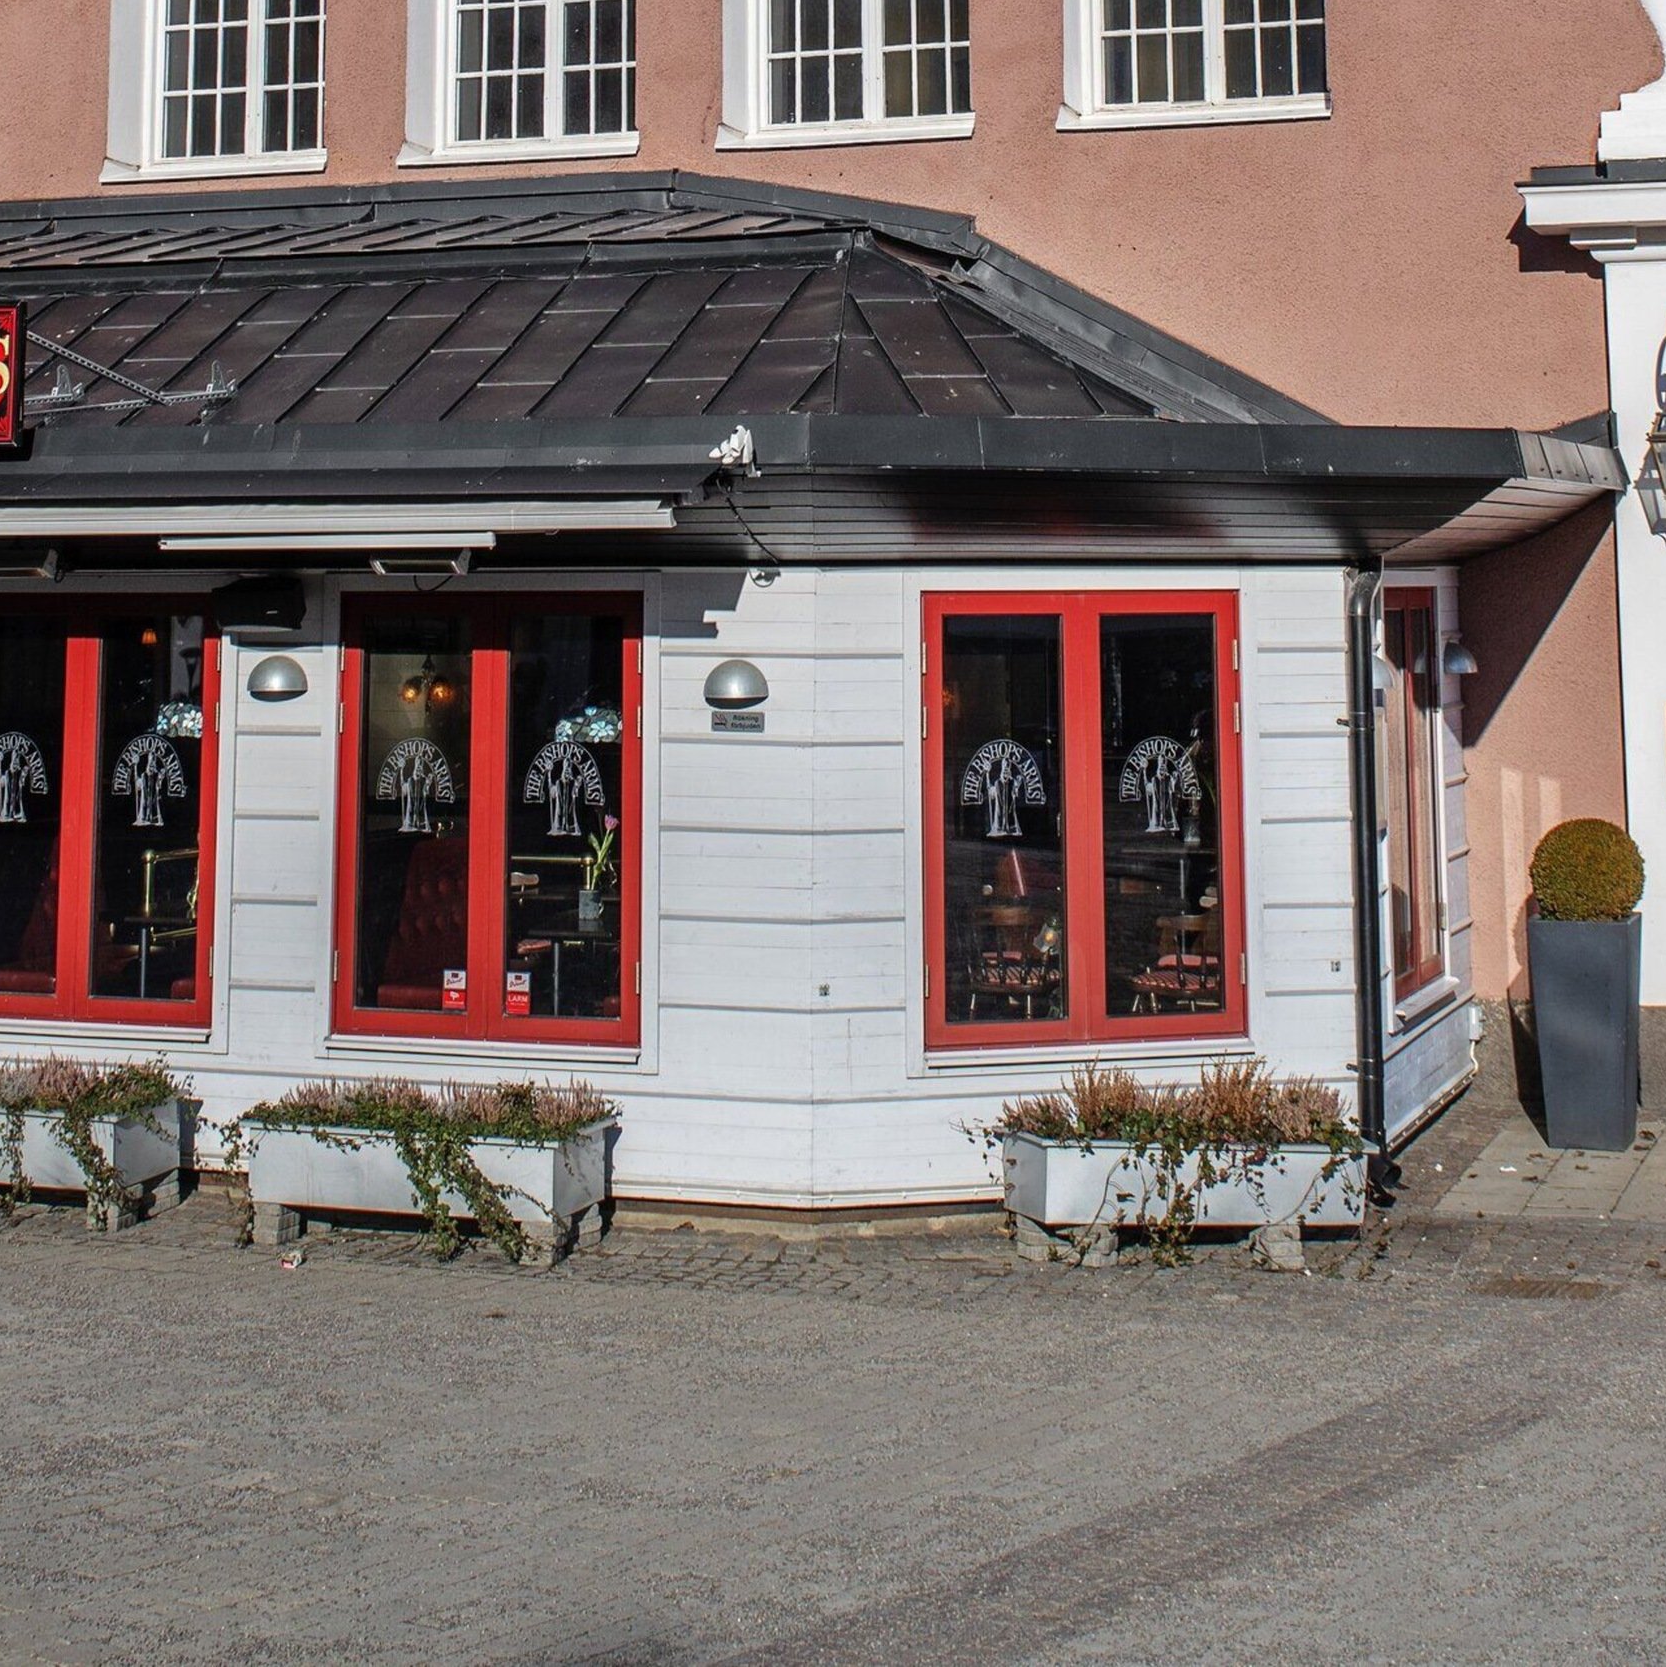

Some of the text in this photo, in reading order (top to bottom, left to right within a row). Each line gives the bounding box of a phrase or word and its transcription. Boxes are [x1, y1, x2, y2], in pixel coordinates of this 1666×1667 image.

[26, 750, 45, 790] ARMS
[114, 737, 183, 793] THE BISHOPS ARMS
[379, 740, 450, 799] THE BISHOPS ARMS
[526, 742, 601, 802] THE BISHOPS ARMS
[963, 741, 1041, 802] THE BISHOPS ARMS
[1122, 738, 1199, 800] THE BISHOPS ARMS
[508, 995, 528, 1003] LARM
